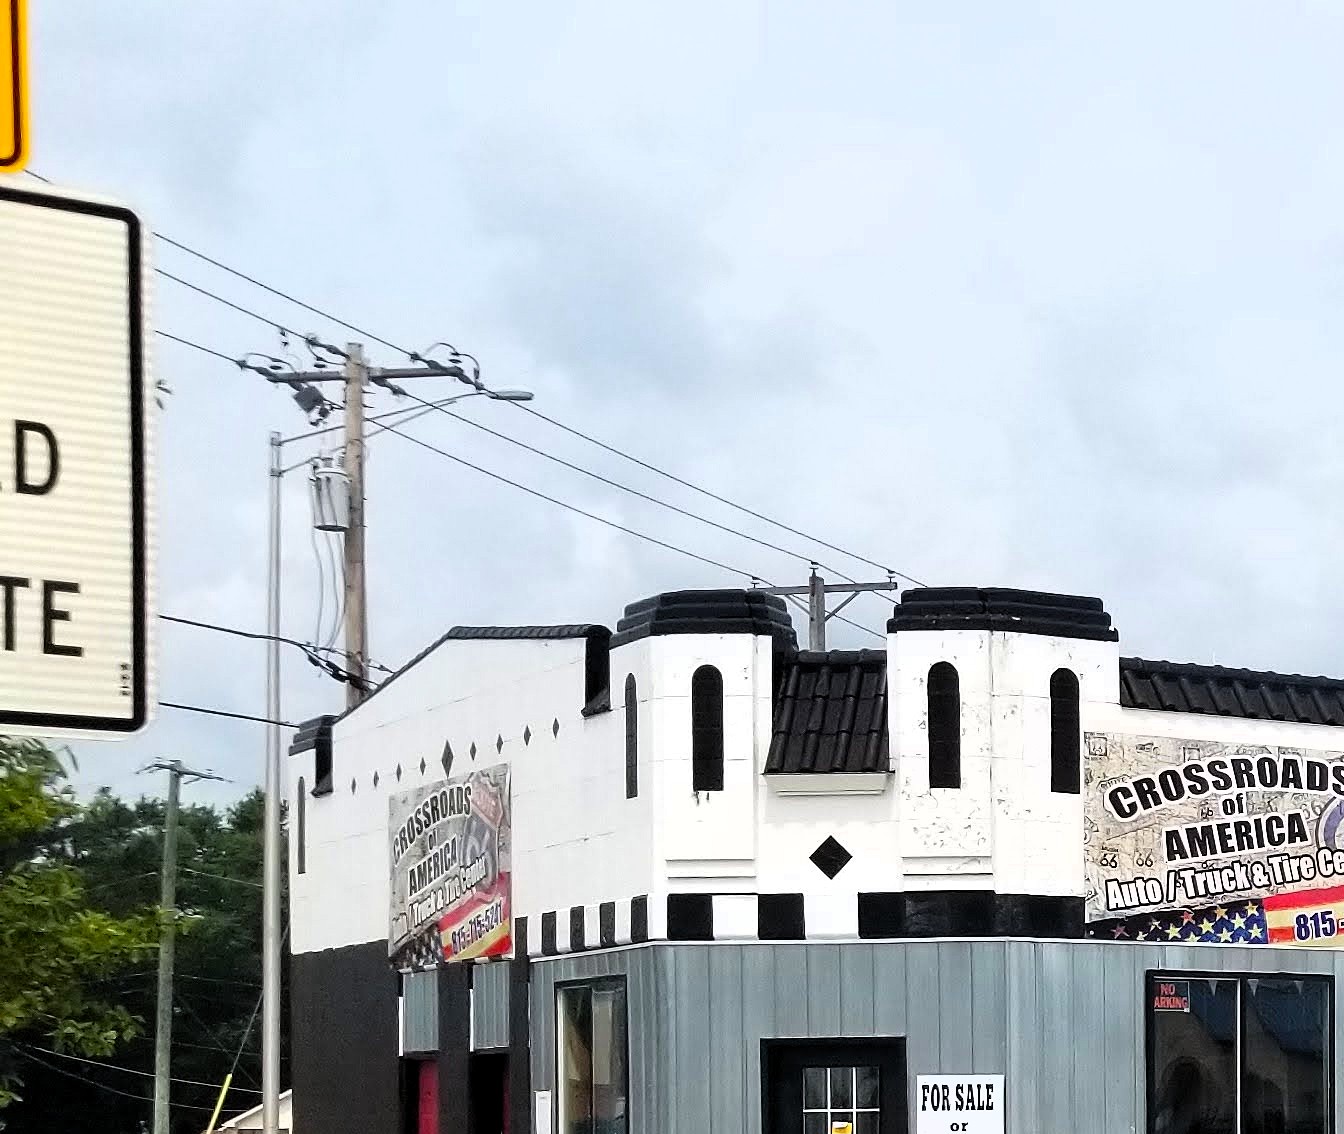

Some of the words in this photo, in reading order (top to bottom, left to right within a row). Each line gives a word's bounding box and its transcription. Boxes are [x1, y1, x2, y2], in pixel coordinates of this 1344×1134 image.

[0, 419, 59, 495] D
[1222, 793, 1243, 815] of
[393, 785, 472, 864] CROSSROADS
[1165, 813, 1308, 861] AMERICA
[409, 837, 457, 896] AMERICA
[1106, 877, 1163, 910] Auto
[1178, 860, 1251, 899] Truck
[1251, 861, 1270, 888] &
[1268, 852, 1316, 885] Tire
[1153, 996, 1188, 1008] ARKING
[1160, 983, 1175, 995] NO
[921, 1084, 950, 1111] FOR
[955, 1084, 994, 1111] SALE
[950, 1121, 969, 1132] or
